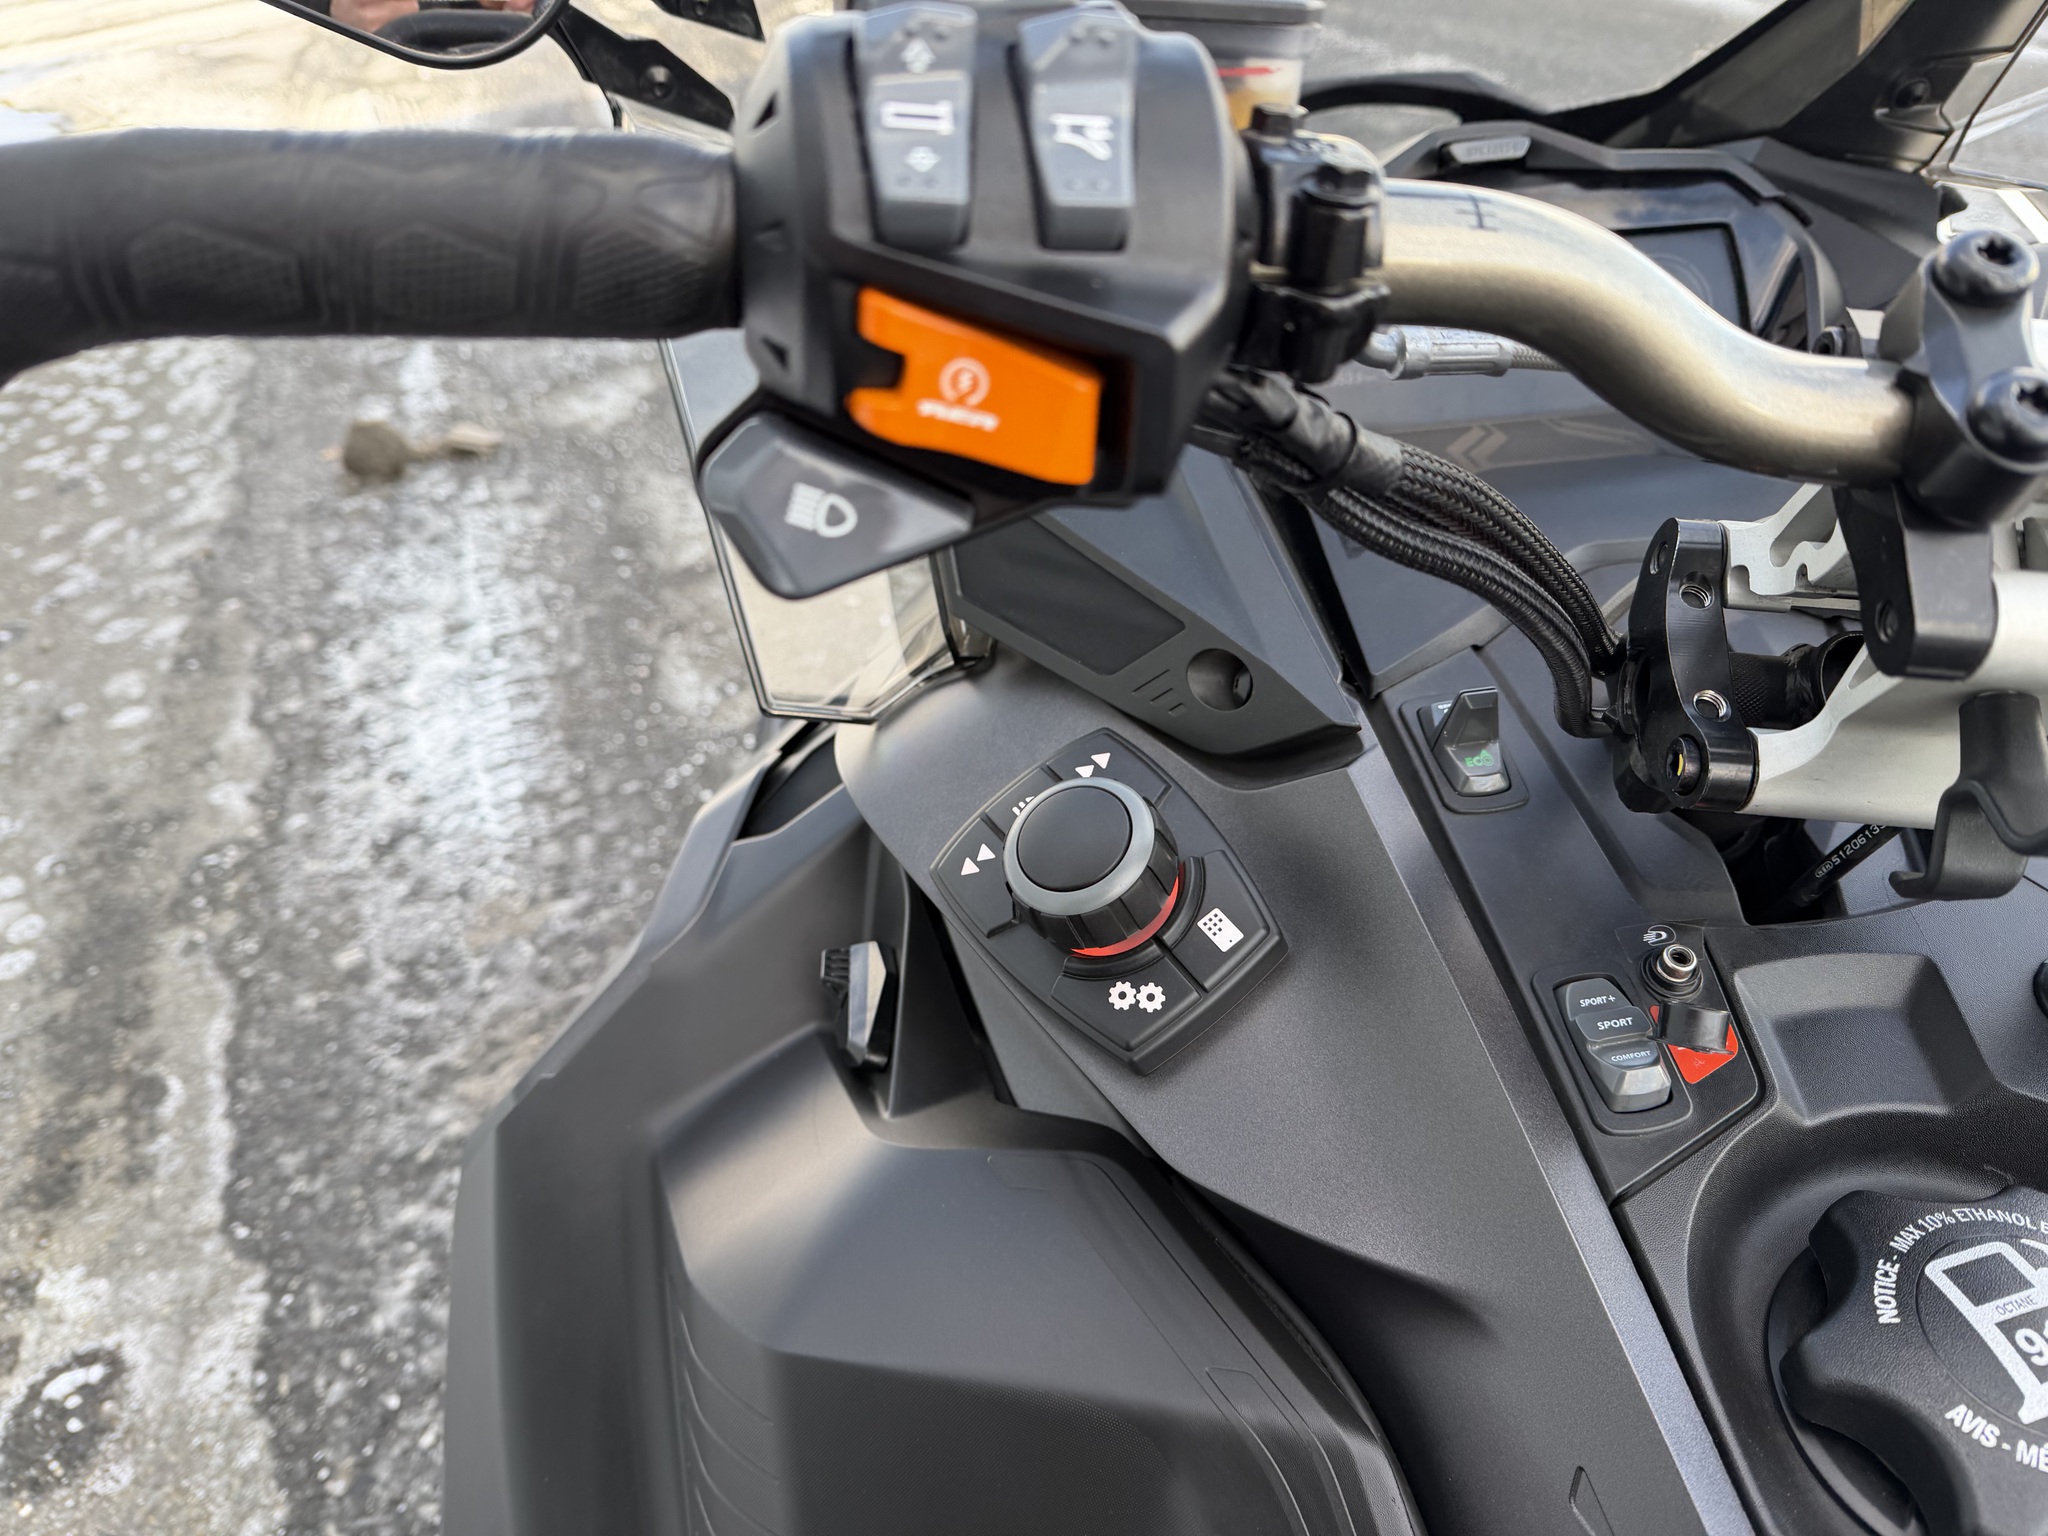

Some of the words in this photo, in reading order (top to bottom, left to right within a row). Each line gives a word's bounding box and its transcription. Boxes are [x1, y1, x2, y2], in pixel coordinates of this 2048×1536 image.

[1464, 749, 1494, 768] ECO
[1597, 1017, 1633, 1030] SPORT
[1611, 1050, 1651, 1062] COMFORT
[1873, 1258, 1901, 1324] NOTICE
[1889, 1224, 1926, 1254] MAX
[1917, 1211, 1956, 1232] 10%
[1952, 1207, 2037, 1230] ETHANOL
[1995, 1294, 2039, 1316] OCTANE
[2014, 1319, 2048, 1366] 9
[1944, 1403, 2000, 1448] AVIS
